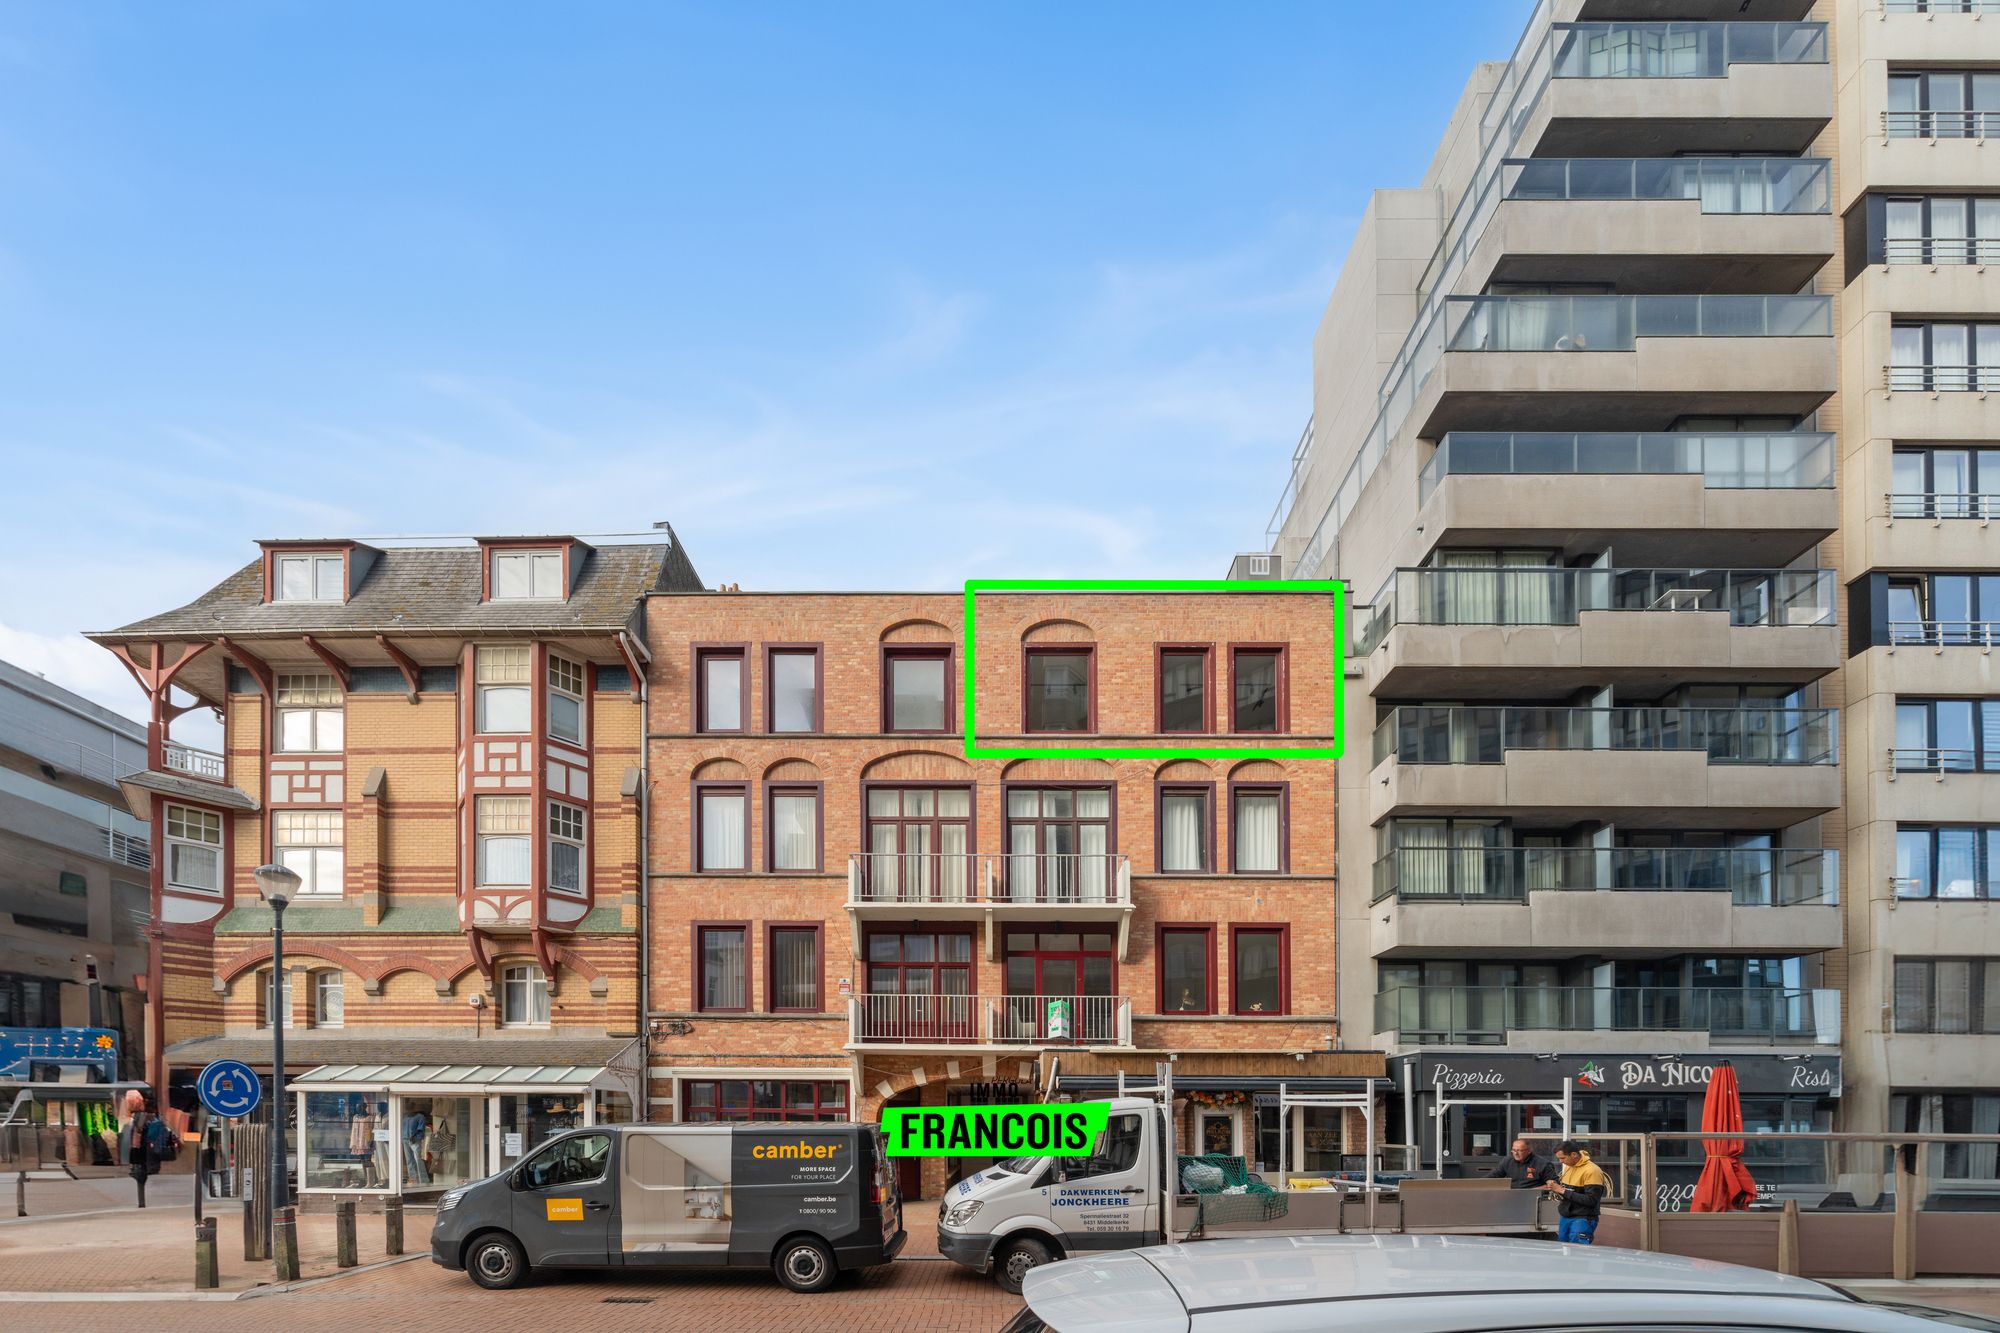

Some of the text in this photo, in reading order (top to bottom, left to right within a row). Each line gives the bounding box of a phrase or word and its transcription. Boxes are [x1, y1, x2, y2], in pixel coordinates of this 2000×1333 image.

[1432, 1063, 1505, 1090] Pizzeria
[752, 1140, 837, 1159] camber
[1041, 1188, 1047, 1196] 5
[1060, 1188, 1120, 1196] DAKWERKEN
[1051, 1198, 1130, 1207] JONCKHEERE
